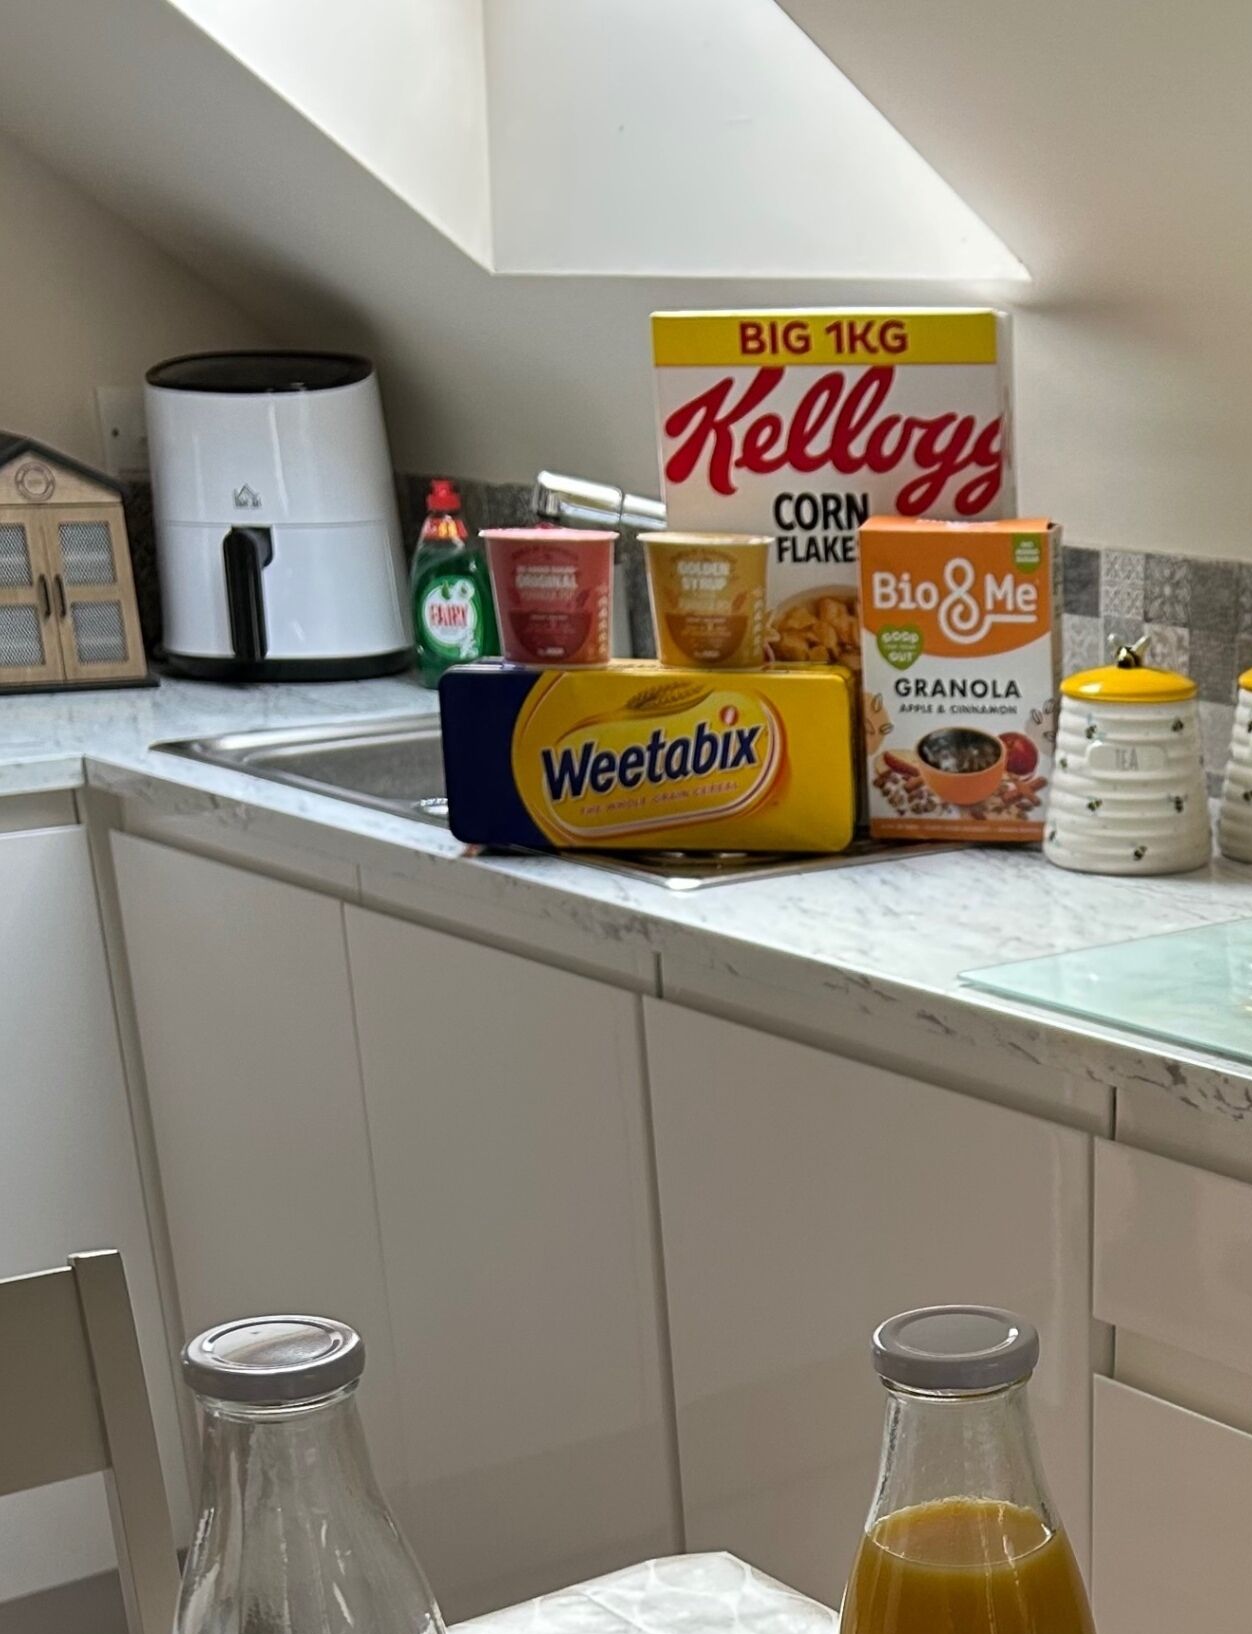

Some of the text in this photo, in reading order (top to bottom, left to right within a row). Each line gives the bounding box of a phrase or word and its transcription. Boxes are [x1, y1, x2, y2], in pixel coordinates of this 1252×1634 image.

[739, 320, 908, 355] BIG 1KG
[774, 492, 869, 531] CORN
[776, 535, 858, 563] FLAKE
[430, 604, 469, 628] FAIRY
[881, 631, 920, 643] GOOD
[894, 678, 1021, 699] GRANOLA
[899, 703, 933, 714] APPLE
[950, 704, 1018, 715] CINNAMON
[541, 704, 762, 802] Weetabix
[1114, 748, 1140, 772] TEA
